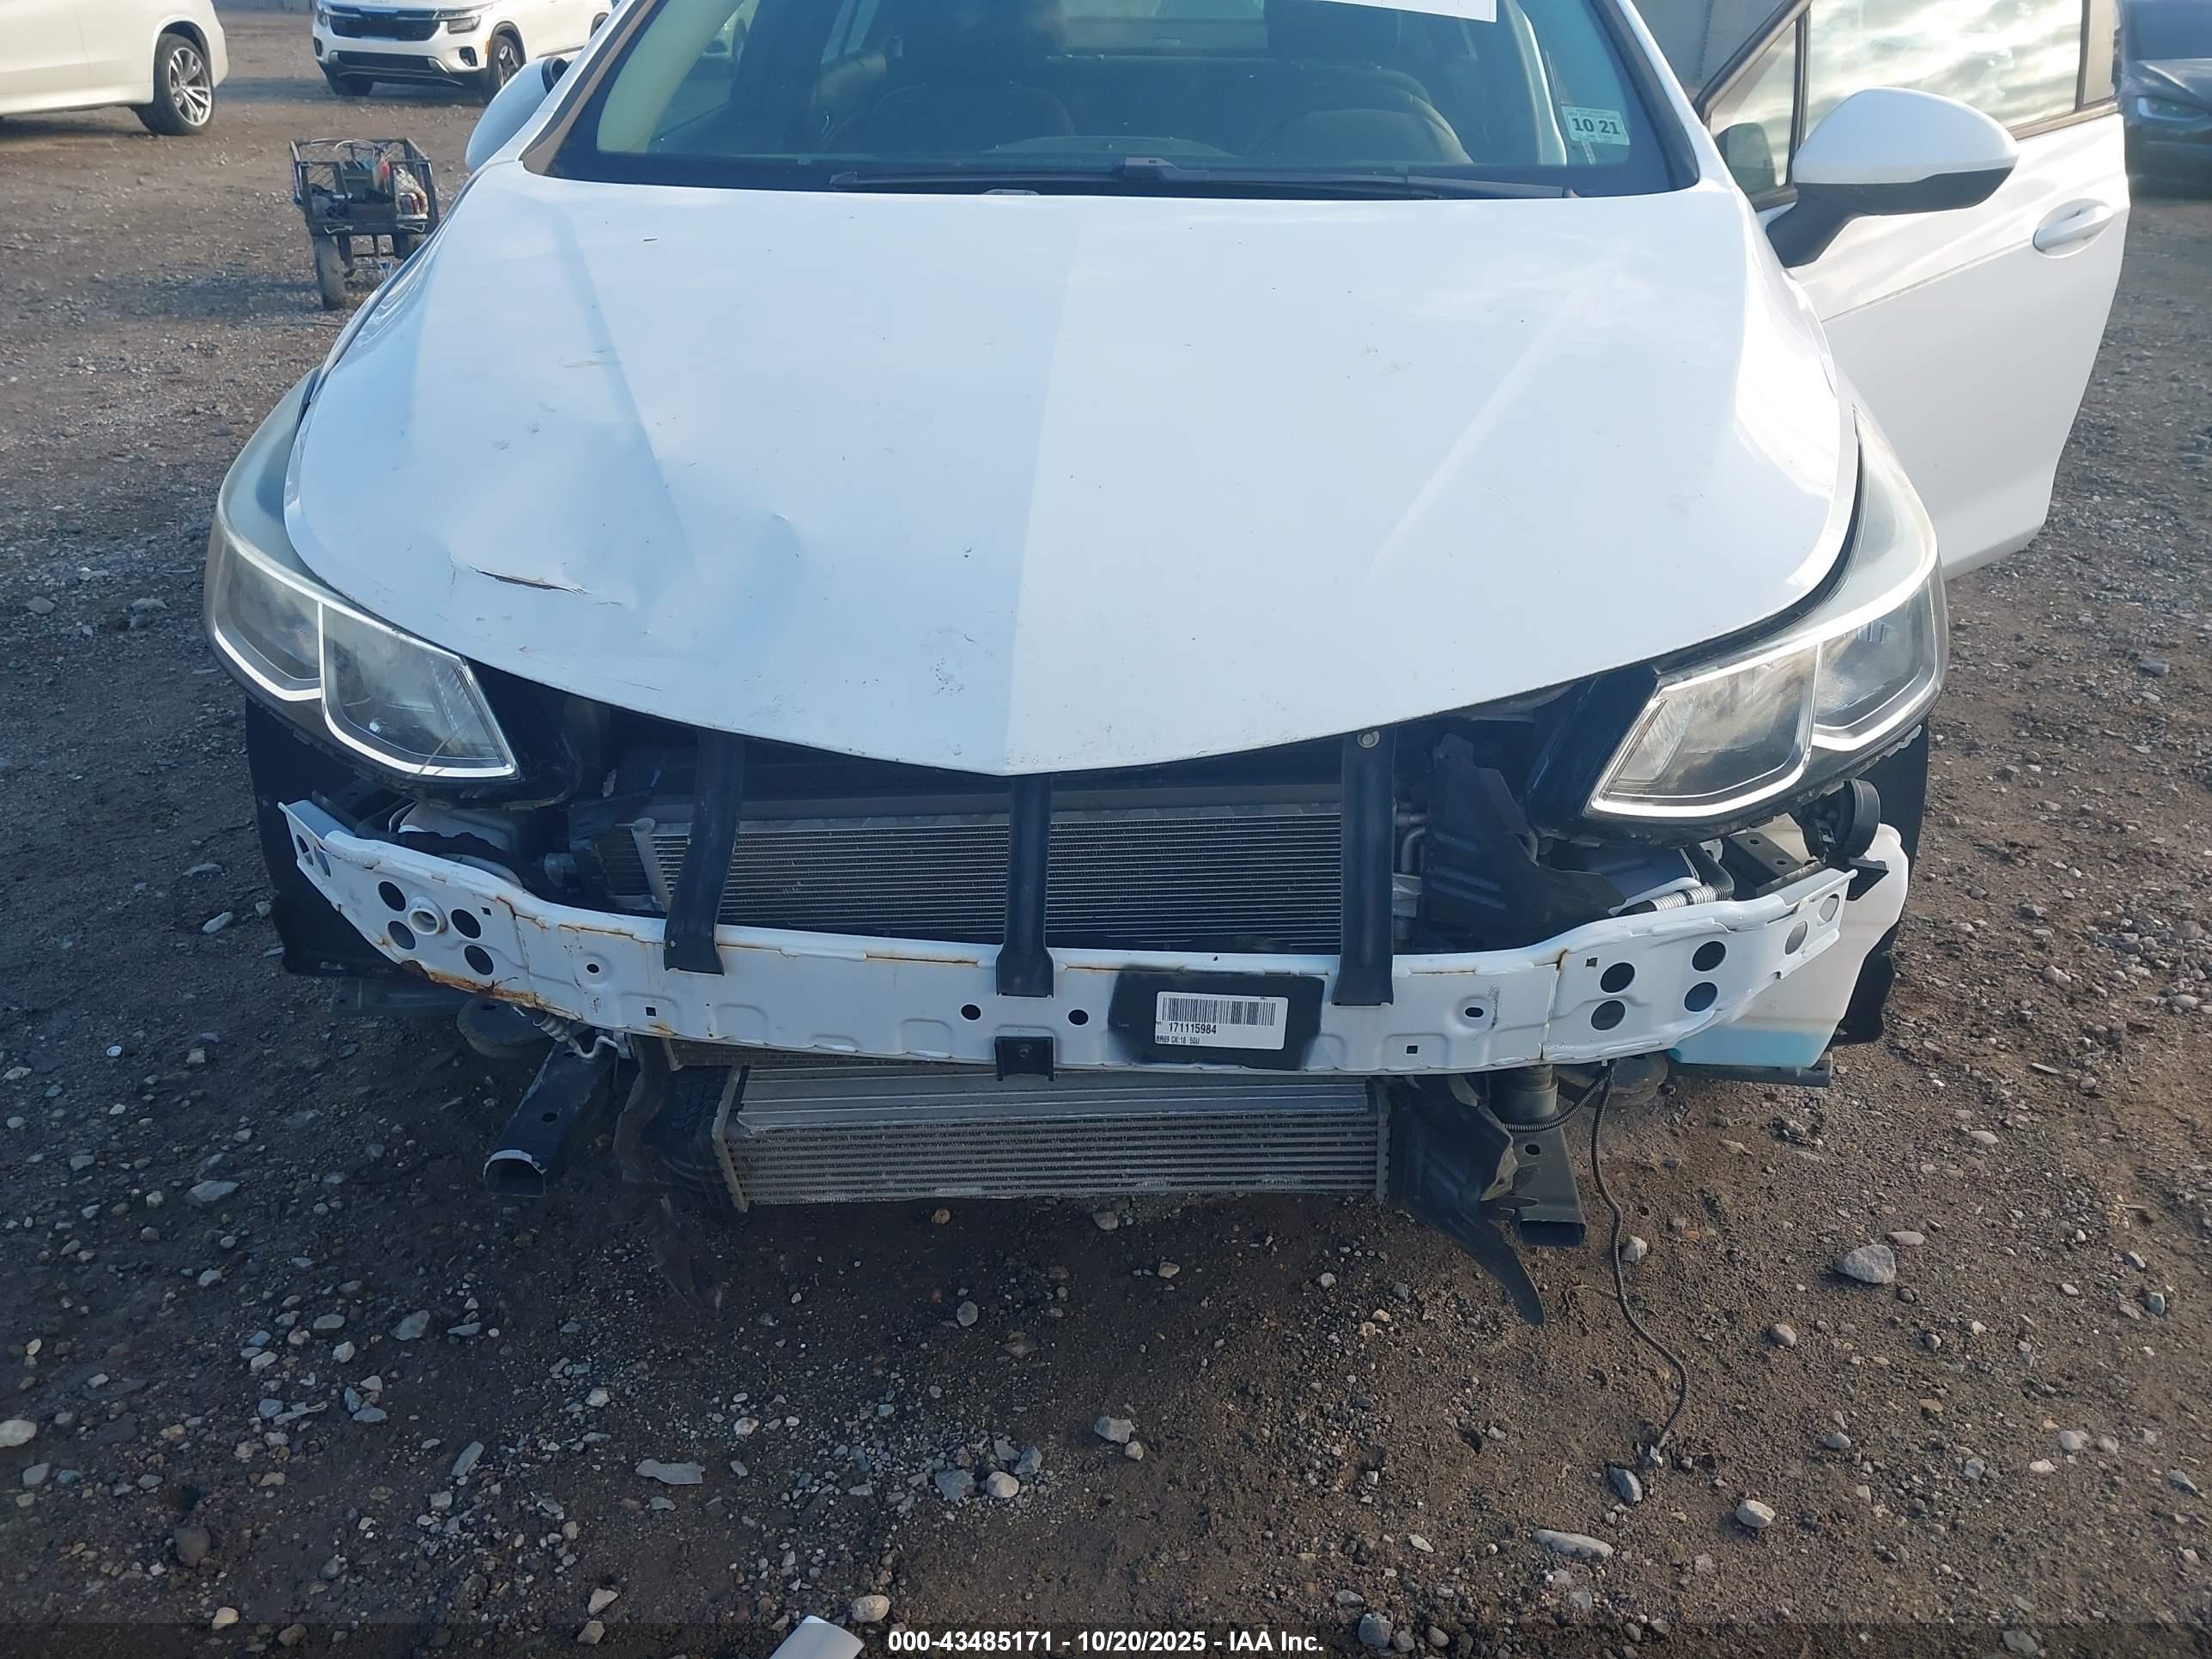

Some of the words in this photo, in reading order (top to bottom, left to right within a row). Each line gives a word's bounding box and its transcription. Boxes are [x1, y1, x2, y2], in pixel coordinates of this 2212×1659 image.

[1572, 118, 1595, 132] 10
[1598, 120, 1620, 135] 21
[1169, 1022, 1217, 1034] 171115984
